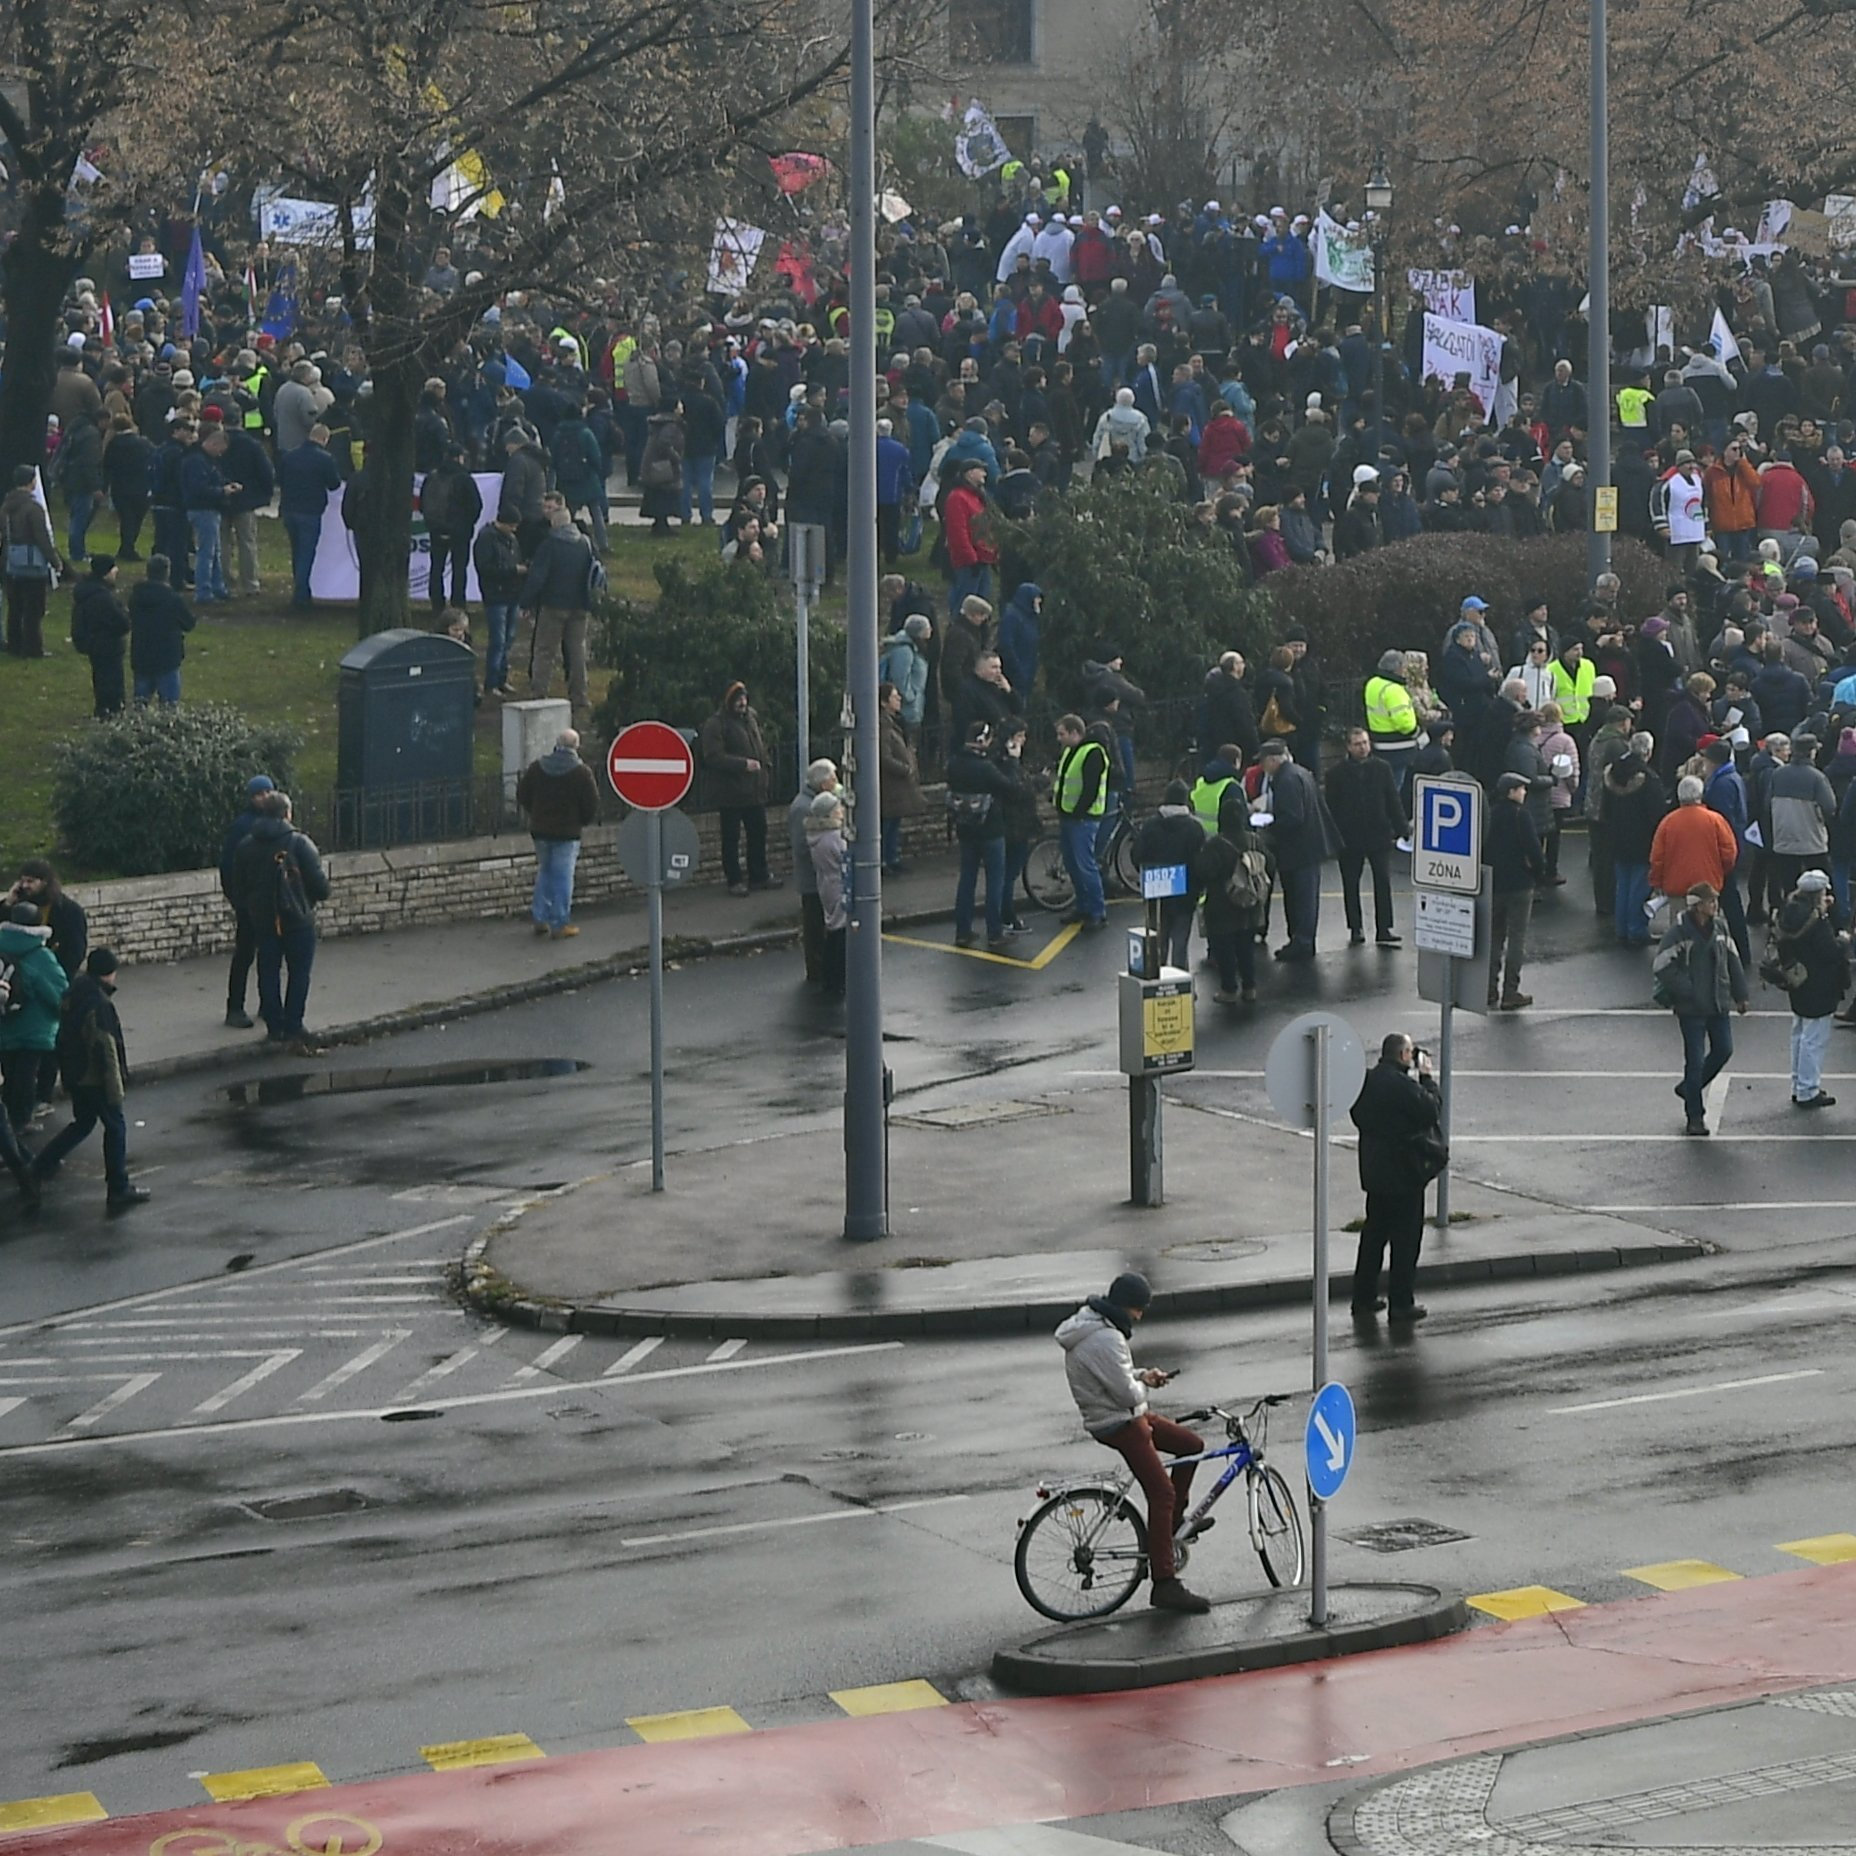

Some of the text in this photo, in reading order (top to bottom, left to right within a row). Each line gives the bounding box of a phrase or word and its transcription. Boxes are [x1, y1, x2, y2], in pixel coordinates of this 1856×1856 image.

[1431, 793, 1462, 848] P
[1144, 867, 1176, 882] 0502
[1428, 860, 1462, 880] ZÓNA
[1129, 939, 1142, 965] P
